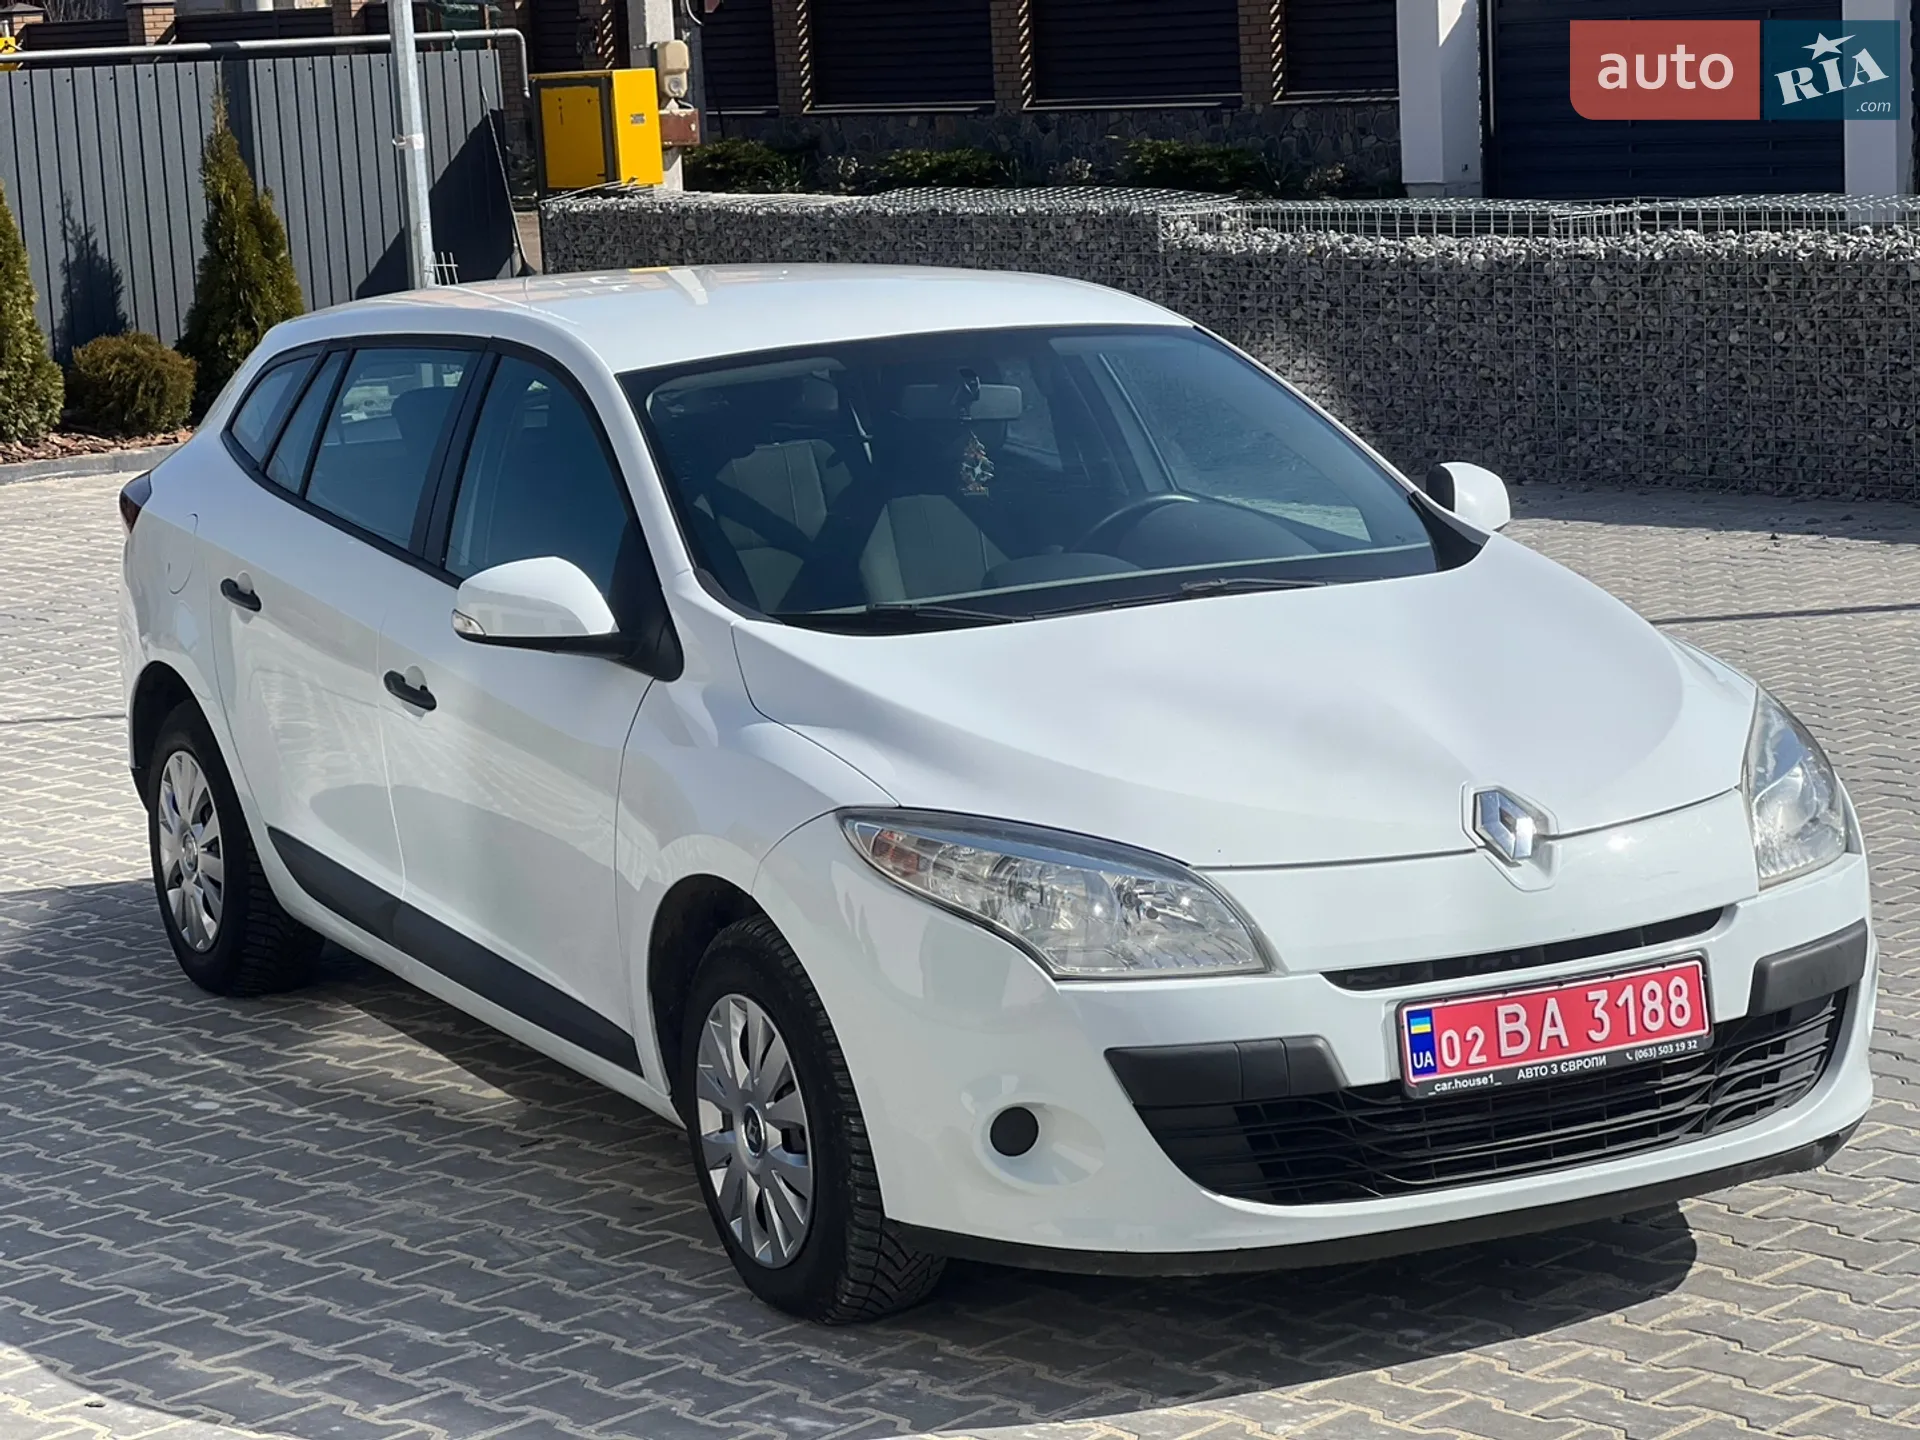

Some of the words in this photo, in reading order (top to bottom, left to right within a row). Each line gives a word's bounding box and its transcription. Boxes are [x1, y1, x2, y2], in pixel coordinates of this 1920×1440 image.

[1440, 1025, 1487, 1068] 02
[1497, 997, 1569, 1057] BA
[1587, 976, 1691, 1042] 3188
[1413, 1050, 1434, 1069] UA
[1634, 1047, 1657, 1061] (063)
[1658, 1043, 1674, 1056] 503
[1675, 1042, 1686, 1052] 19
[1687, 1040, 1698, 1050] 32
[1517, 1066, 1548, 1080] АВТО
[1561, 1055, 1607, 1072] ЄВРОПИ
[1428, 1073, 1502, 1095] _car.house1_
